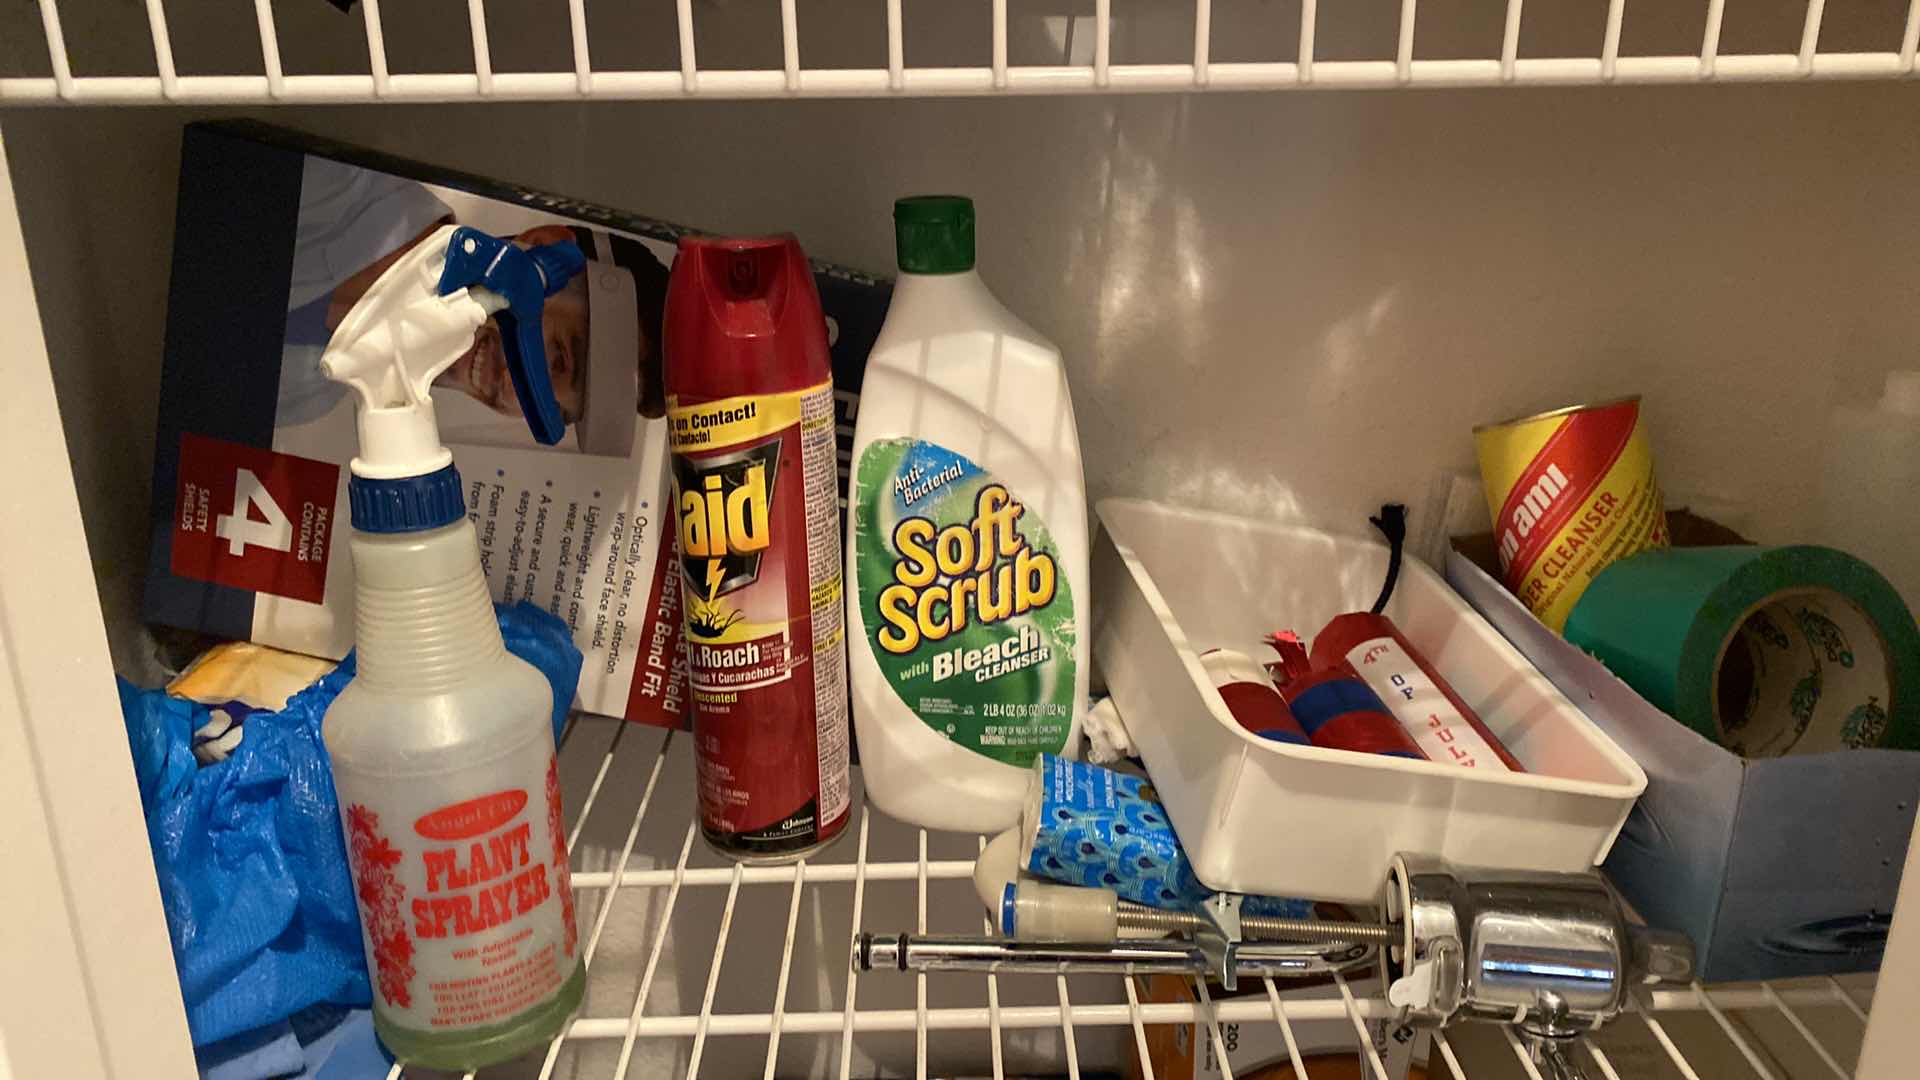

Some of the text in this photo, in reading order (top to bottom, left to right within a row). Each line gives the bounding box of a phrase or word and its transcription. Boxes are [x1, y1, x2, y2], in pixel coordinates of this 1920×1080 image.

[691, 401, 756, 430] Contact!
[467, 481, 486, 523] from fr
[487, 484, 505, 517] Foam
[540, 494, 553, 504] A
[894, 464, 925, 496] Anti-
[903, 460, 964, 506] Bacterial
[1512, 463, 1569, 539] ami
[182, 482, 197, 532] SHIELDS
[196, 487, 210, 533] SAFETY
[215, 467, 294, 557] 4
[533, 507, 548, 544] secure
[674, 458, 770, 558] aid
[297, 502, 314, 562] CONTAINS
[311, 506, 328, 562] PACKAGE
[480, 520, 497, 548] strip
[560, 537, 572, 567] quick
[576, 505, 601, 575] Lightweight
[625, 516, 648, 569] Optically
[893, 484, 1025, 588] Soft
[1524, 576, 1548, 611] DER
[1541, 490, 1619, 579] CLEANSER
[528, 548, 541, 571] and
[554, 570, 566, 593] and
[592, 512, 625, 650] wrap-around face shield.
[503, 574, 519, 603] elast
[550, 594, 561, 617] eas
[572, 576, 584, 600] and
[616, 602, 628, 618] no
[658, 557, 681, 618] Elastic
[879, 546, 1056, 655] Scrub
[607, 618, 626, 675] distortion
[648, 620, 673, 670] Band
[701, 642, 760, 669] Roach
[899, 624, 1040, 683] with Bleach
[975, 648, 1050, 683] CLEANSER
[641, 670, 663, 699] Fit
[663, 655, 690, 714] Shield
[718, 665, 775, 685] Cucarachas
[1390, 673, 1414, 700] OF
[983, 704, 989, 716] 2
[989, 704, 999, 717] LB
[1000, 704, 1005, 716] 4
[1006, 704, 1015, 717] OZ
[1428, 713, 1476, 768] JULY
[422, 822, 530, 892] PLANT
[411, 863, 550, 939] SPRAYER
[1226, 1023, 1238, 1051] 200
